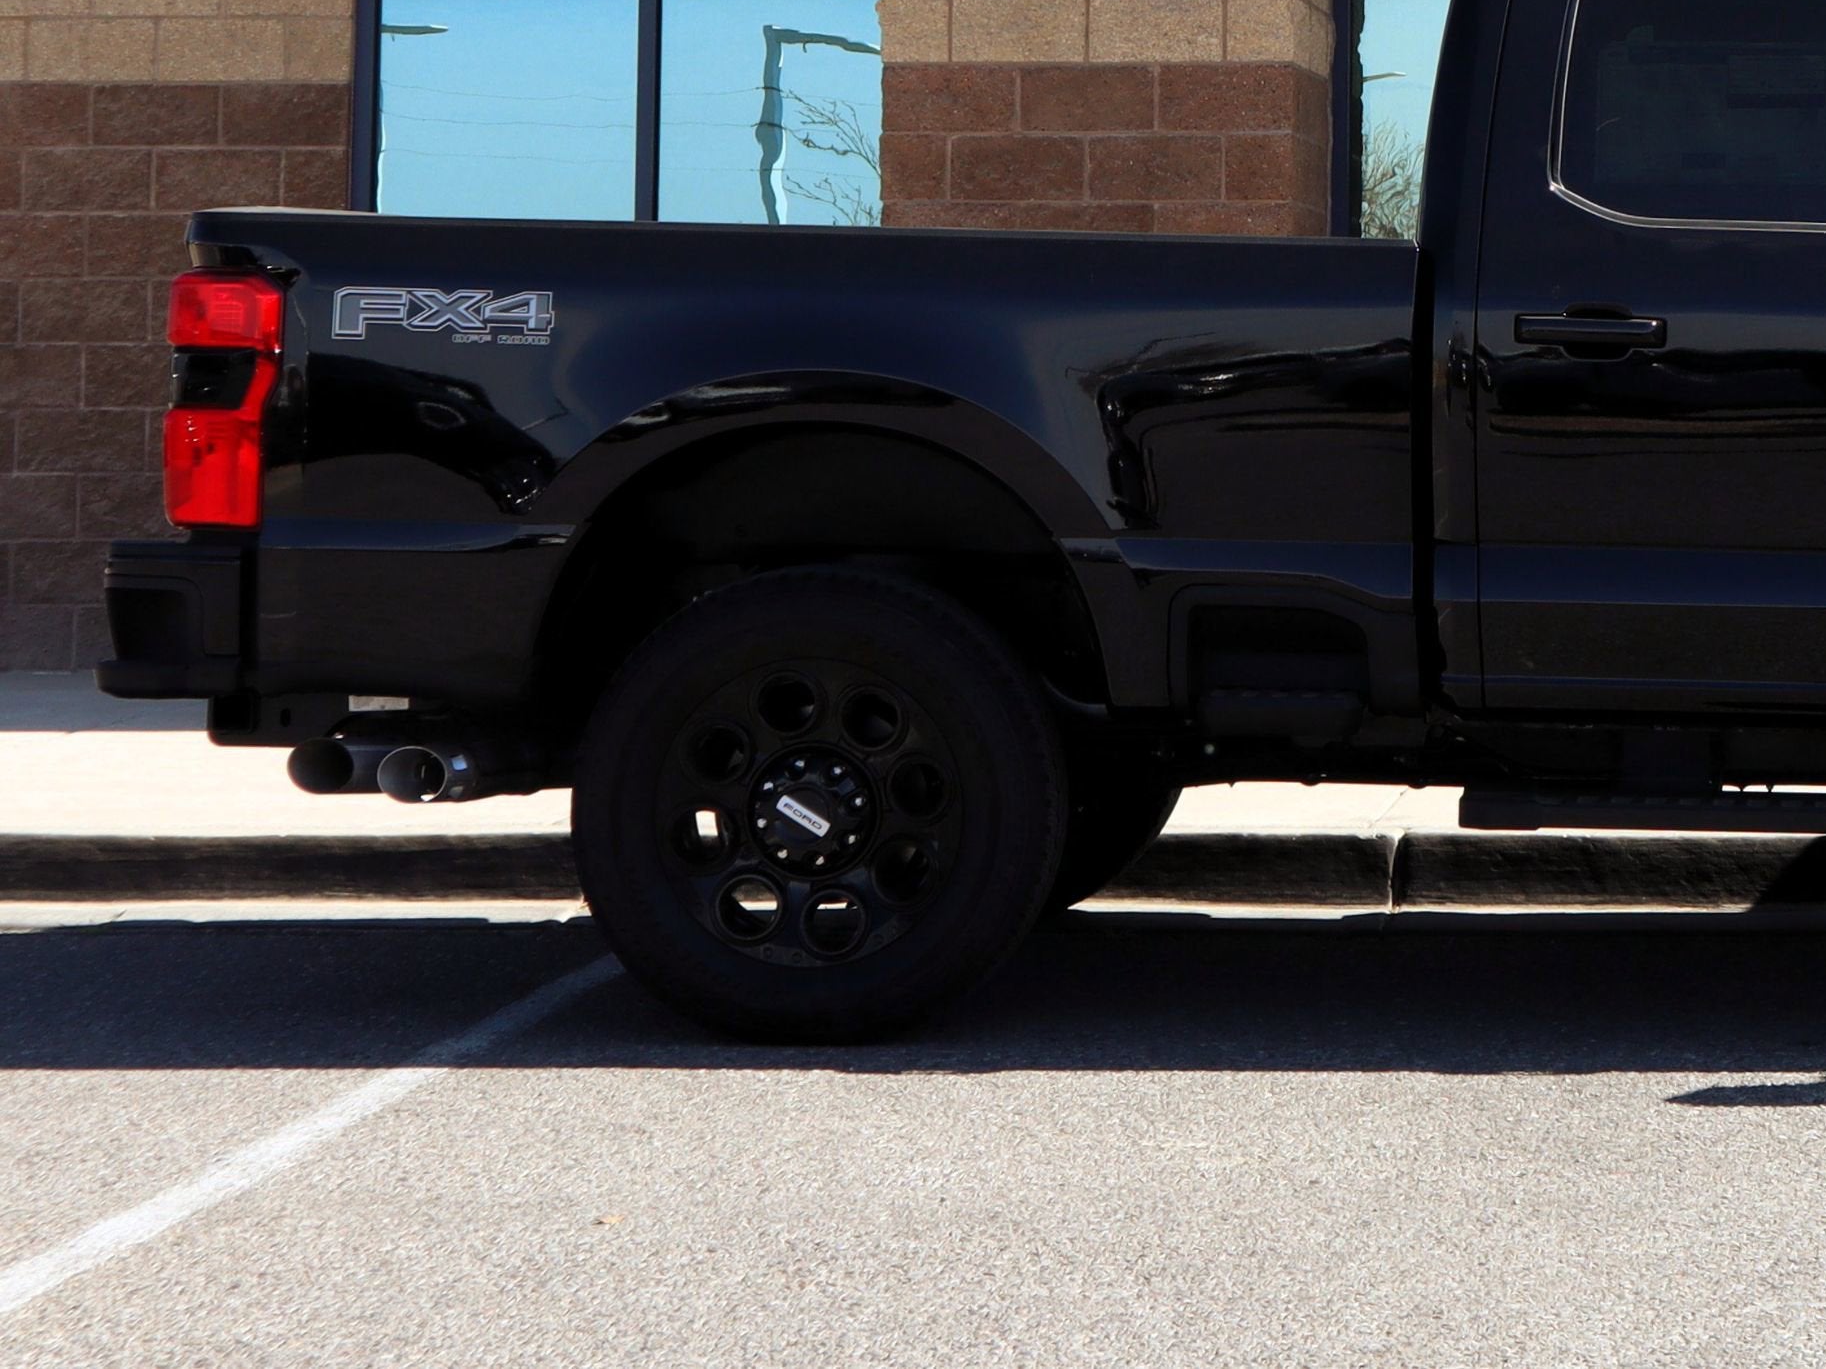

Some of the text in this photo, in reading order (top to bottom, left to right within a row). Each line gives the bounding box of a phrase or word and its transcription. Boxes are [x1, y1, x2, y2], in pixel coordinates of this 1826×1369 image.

[331, 286, 554, 339] FX4
[452, 334, 550, 345] OFF ROAD
[783, 802, 823, 830] FORD
